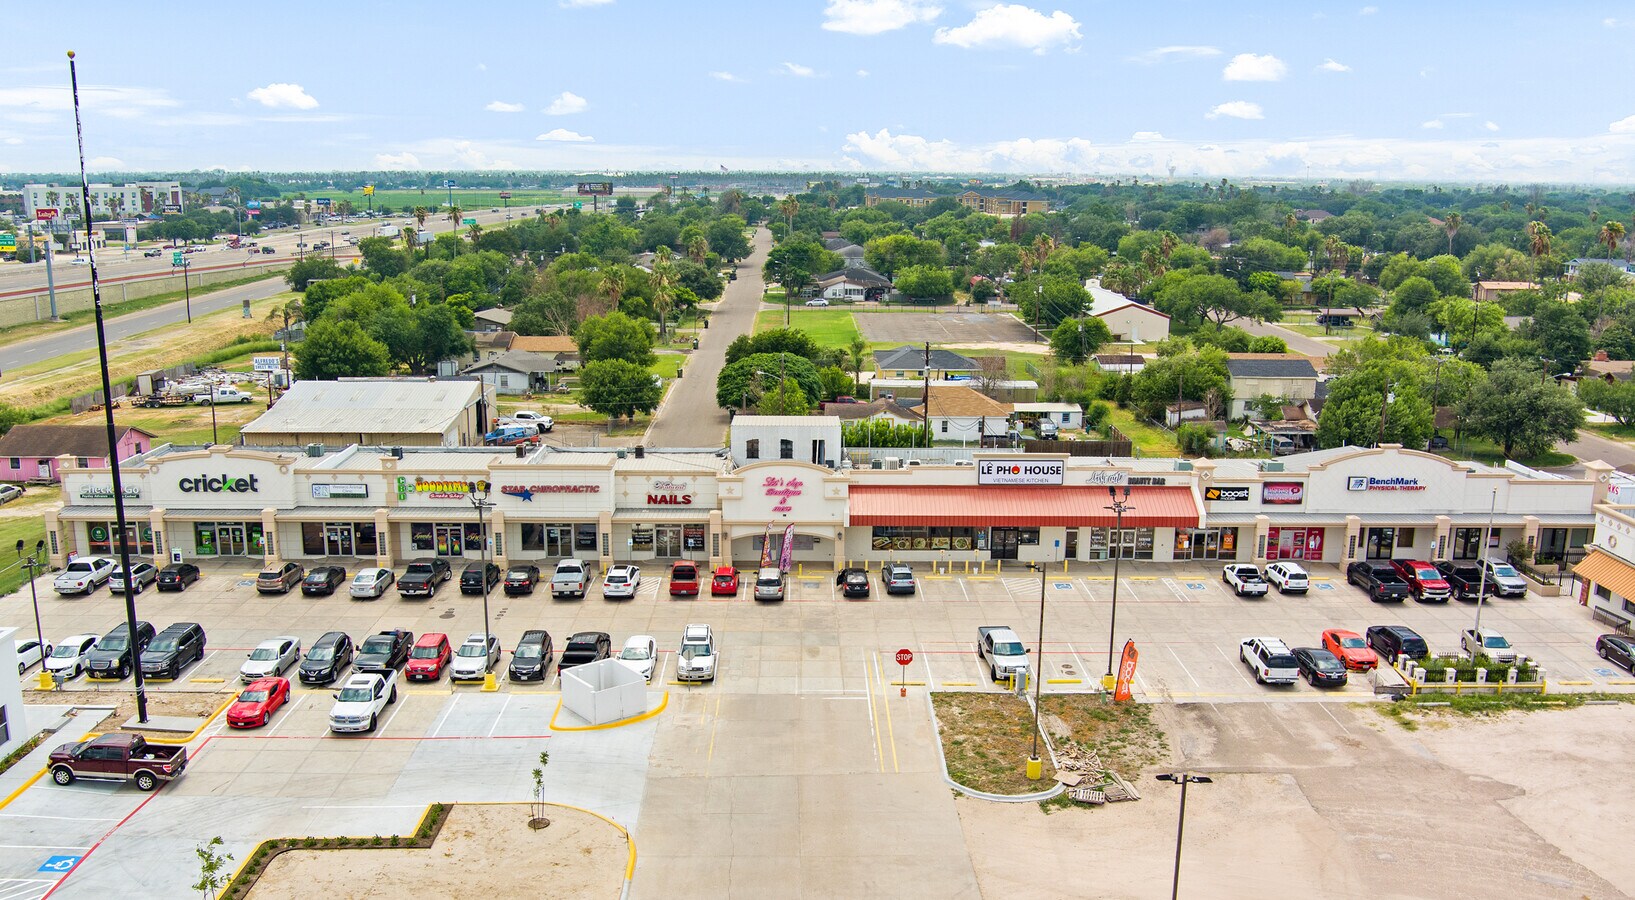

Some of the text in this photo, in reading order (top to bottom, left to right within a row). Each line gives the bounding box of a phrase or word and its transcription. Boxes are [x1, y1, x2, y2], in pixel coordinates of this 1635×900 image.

[1024, 465, 1062, 475] HOUSE
[178, 473, 259, 493] cricket
[1128, 477, 1166, 486] BEAUTY BAR
[1369, 477, 1419, 485] BenchMark
[80, 484, 140, 494] Check Go
[500, 485, 600, 493] STAR CHIROPRACTIC
[1220, 489, 1249, 497] boost
[647, 494, 692, 505] NAILS
[896, 653, 912, 661] STOP
[1121, 661, 1135, 694] boost
